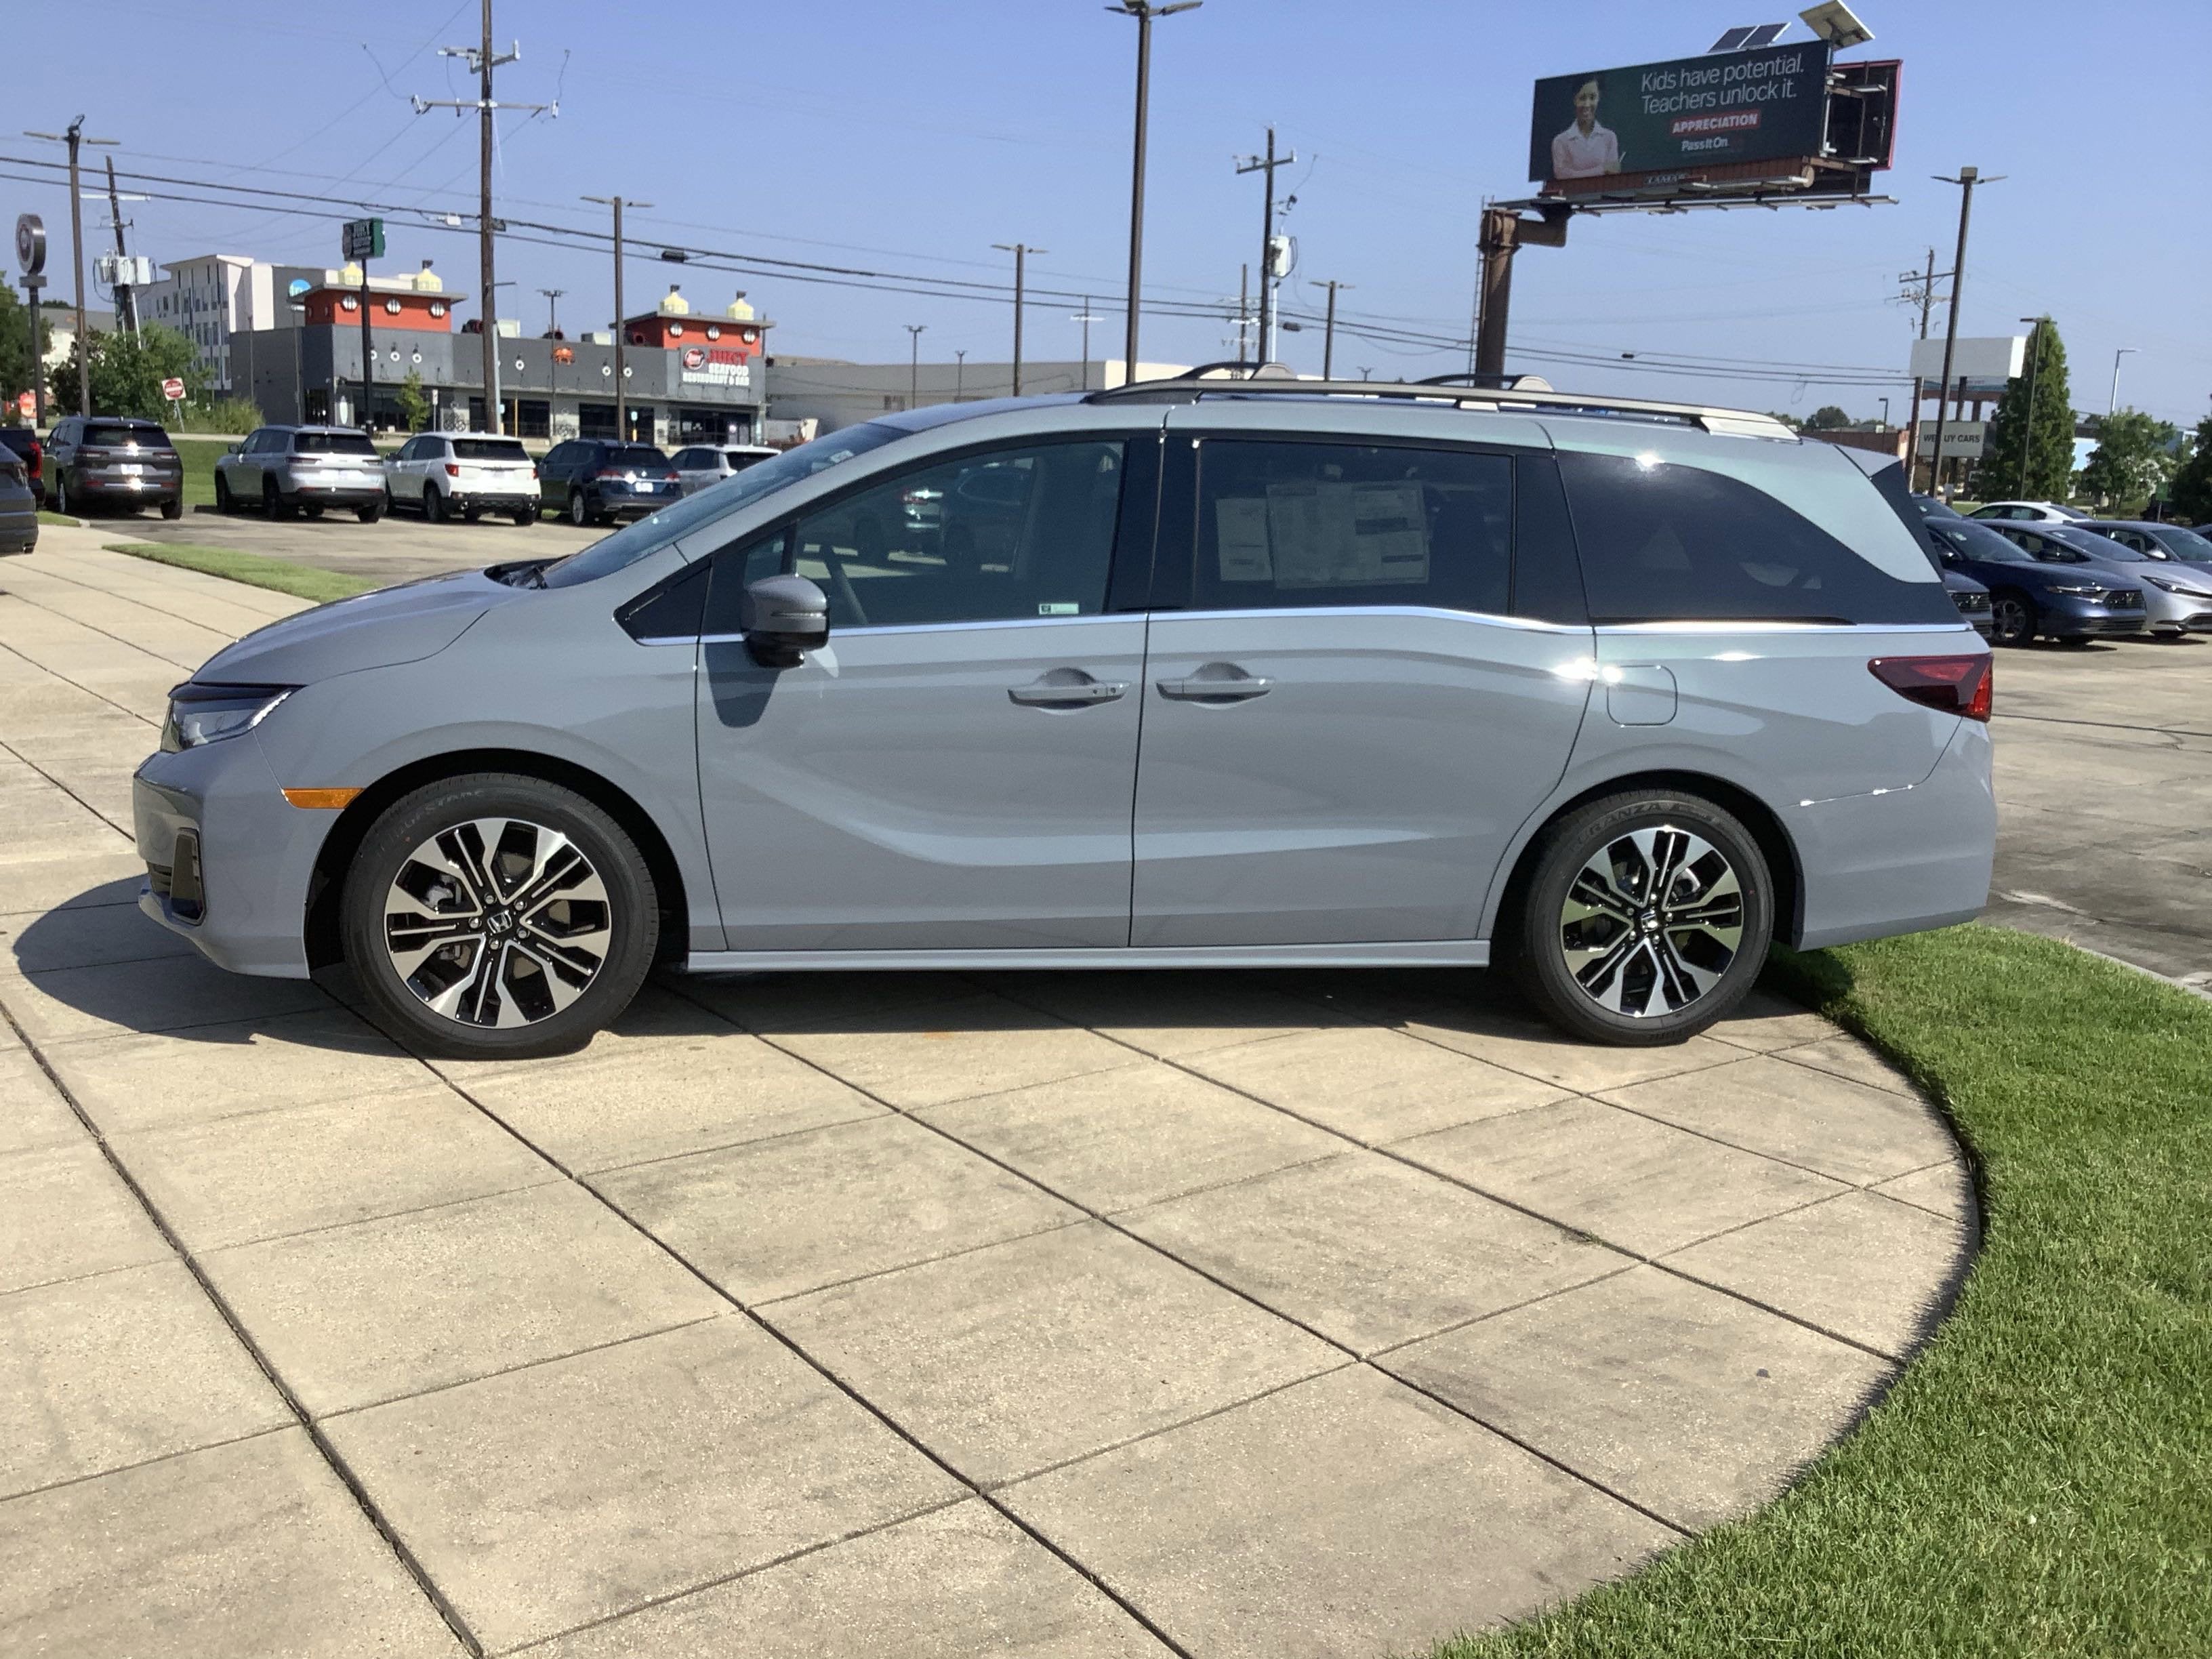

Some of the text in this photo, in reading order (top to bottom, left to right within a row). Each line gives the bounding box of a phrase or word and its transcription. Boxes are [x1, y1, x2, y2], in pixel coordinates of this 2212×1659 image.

[1641, 53, 1804, 93] Kids have potential.
[1641, 78, 1797, 115] Teachers unlock it.
[1672, 113, 1759, 134] APPRECIATION
[706, 349, 748, 365] JUICY
[708, 363, 749, 377] SEAFOOD
[1957, 434, 1980, 443] CARS
